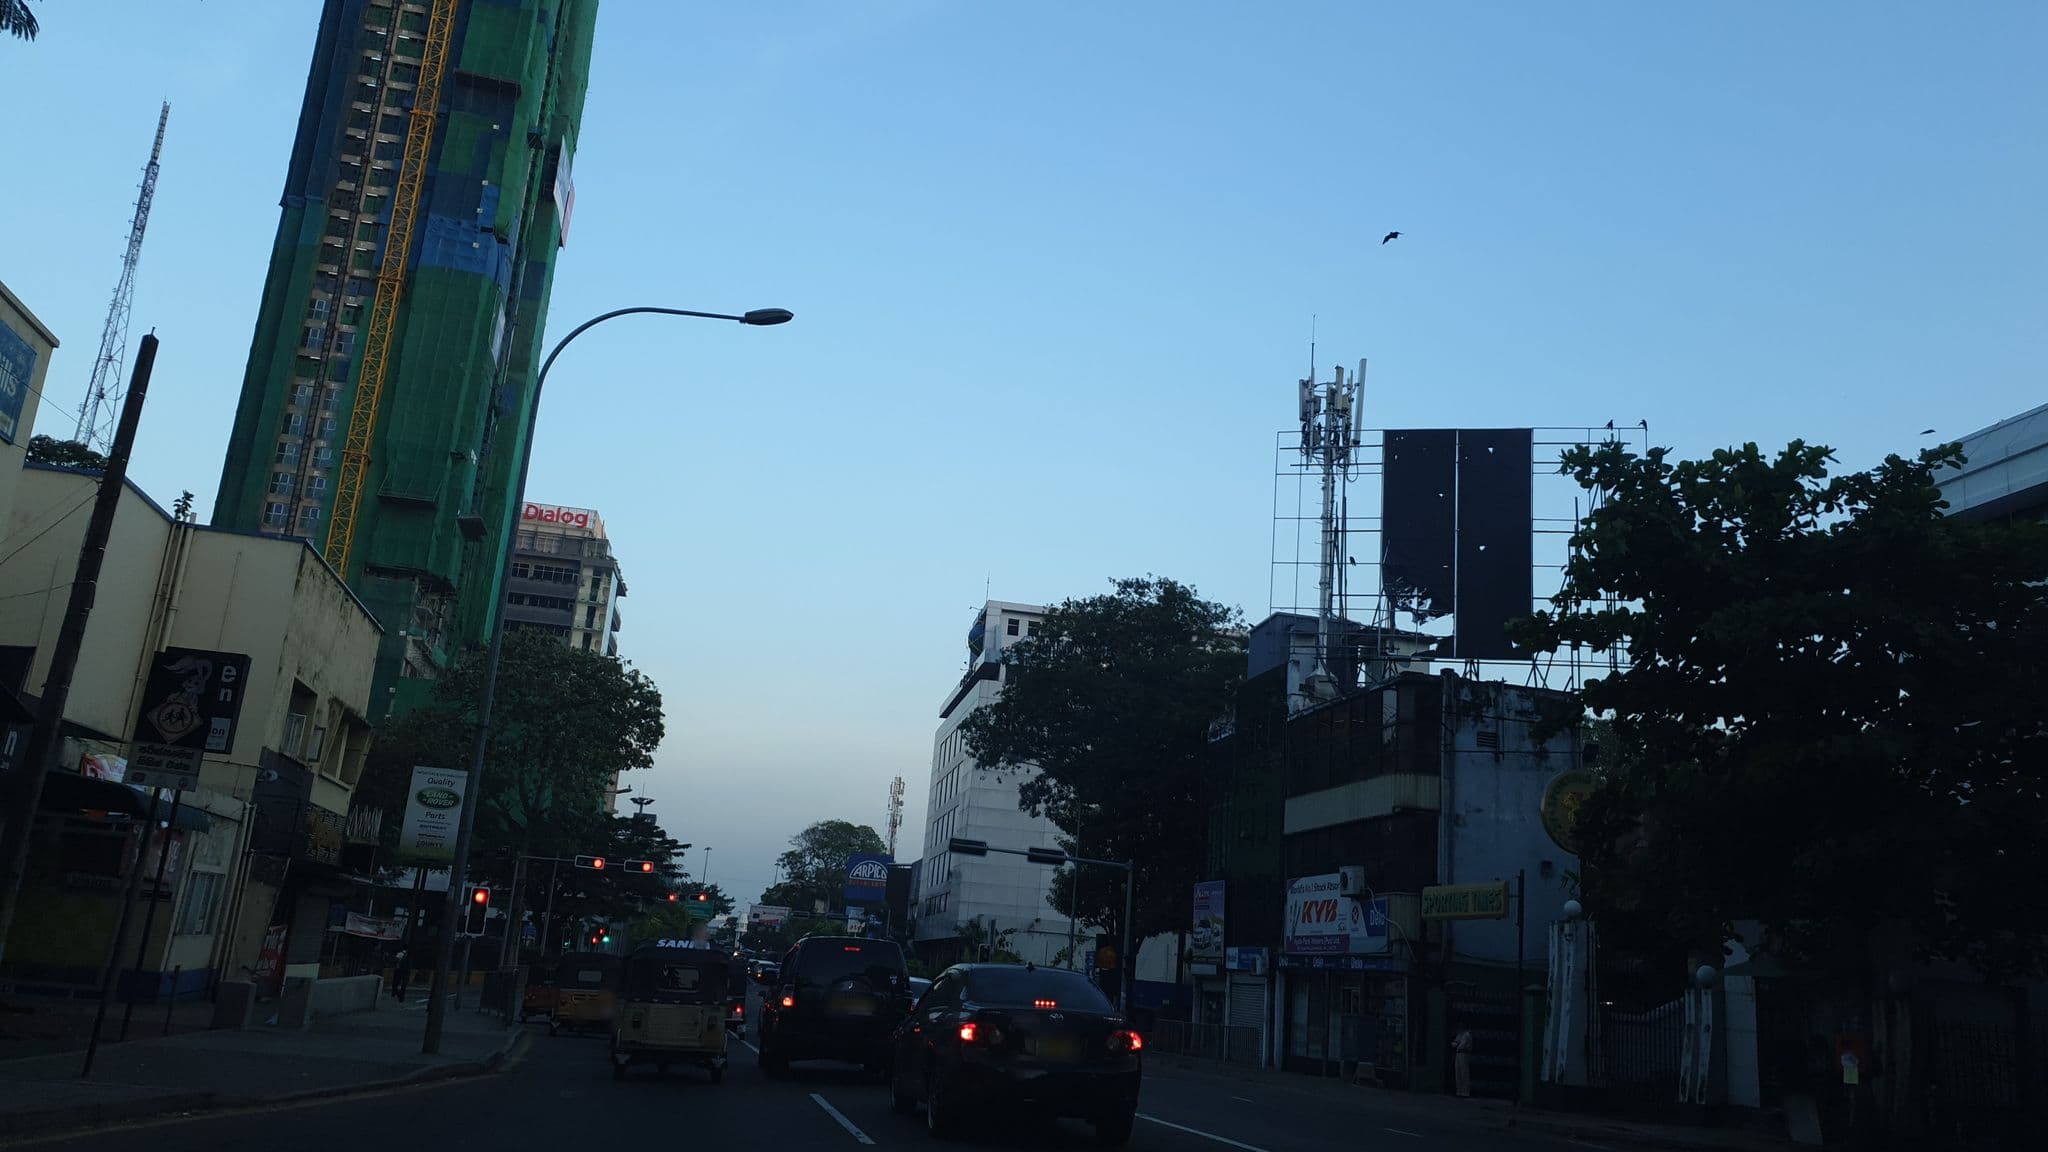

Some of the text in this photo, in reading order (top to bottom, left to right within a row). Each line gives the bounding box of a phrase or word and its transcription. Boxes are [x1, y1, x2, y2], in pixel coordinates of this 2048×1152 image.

[525, 504, 588, 529] Dialog
[427, 777, 455, 787] Quality
[427, 799, 455, 807] ROVER
[425, 811, 446, 820] Parts
[853, 863, 887, 879] ARPICO
[1301, 899, 1338, 923] KYB
